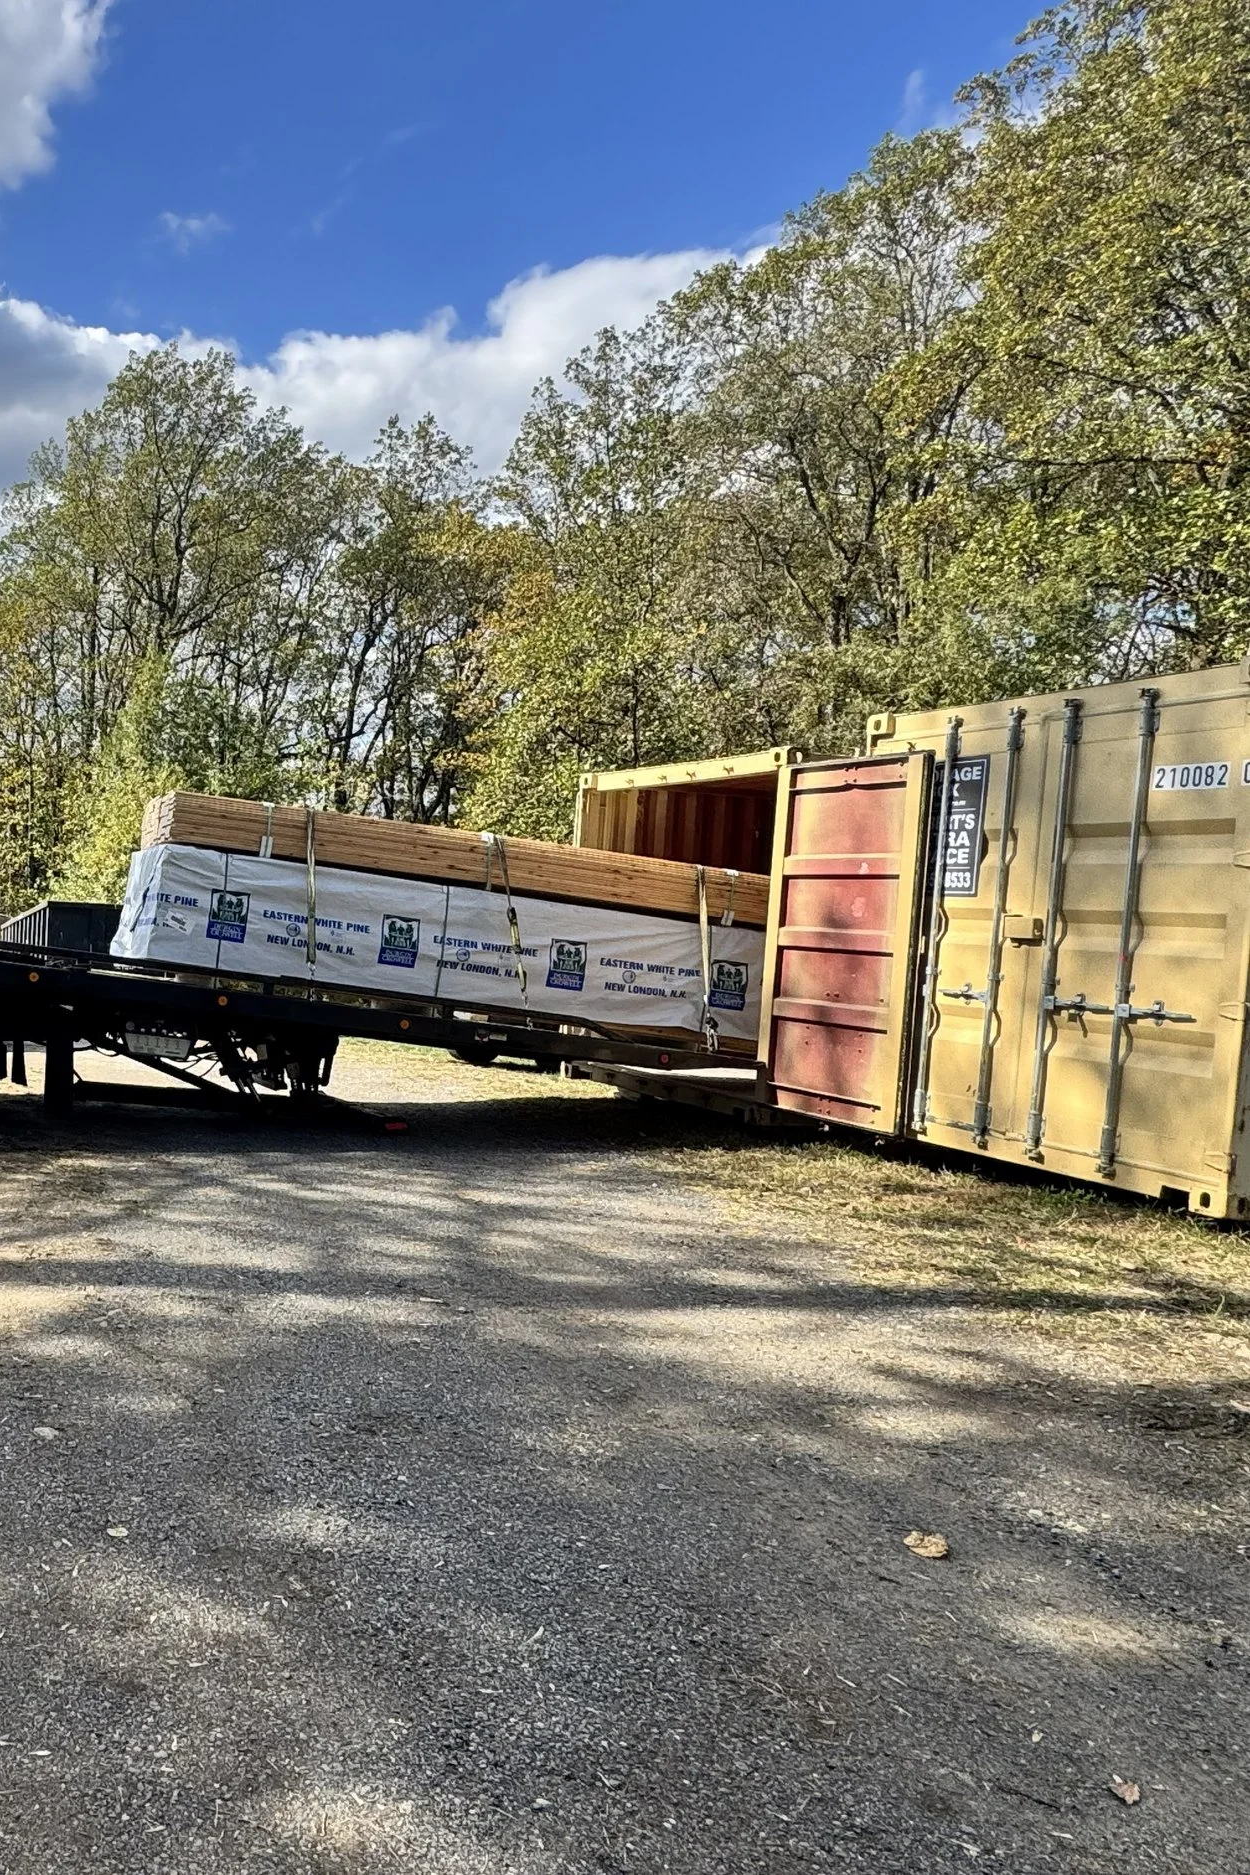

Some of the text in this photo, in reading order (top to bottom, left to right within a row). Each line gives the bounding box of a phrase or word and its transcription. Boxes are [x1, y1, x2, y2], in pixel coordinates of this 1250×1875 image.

[1155, 764, 1228, 789] 210082
[174, 895, 199, 908] PINE
[263, 910, 371, 934] EASTERN WHITE PINE
[266, 934, 290, 945] NEW
[335, 945, 355, 956] N.H.
[433, 935, 478, 950] EASTERN
[481, 942, 512, 954] WHITE
[437, 959, 459, 970] NEW
[461, 963, 502, 977] LONDON,
[600, 957, 701, 977] EASTERN WHITE PINE
[604, 981, 626, 992] NEW
[628, 985, 668, 998] LONDON,
